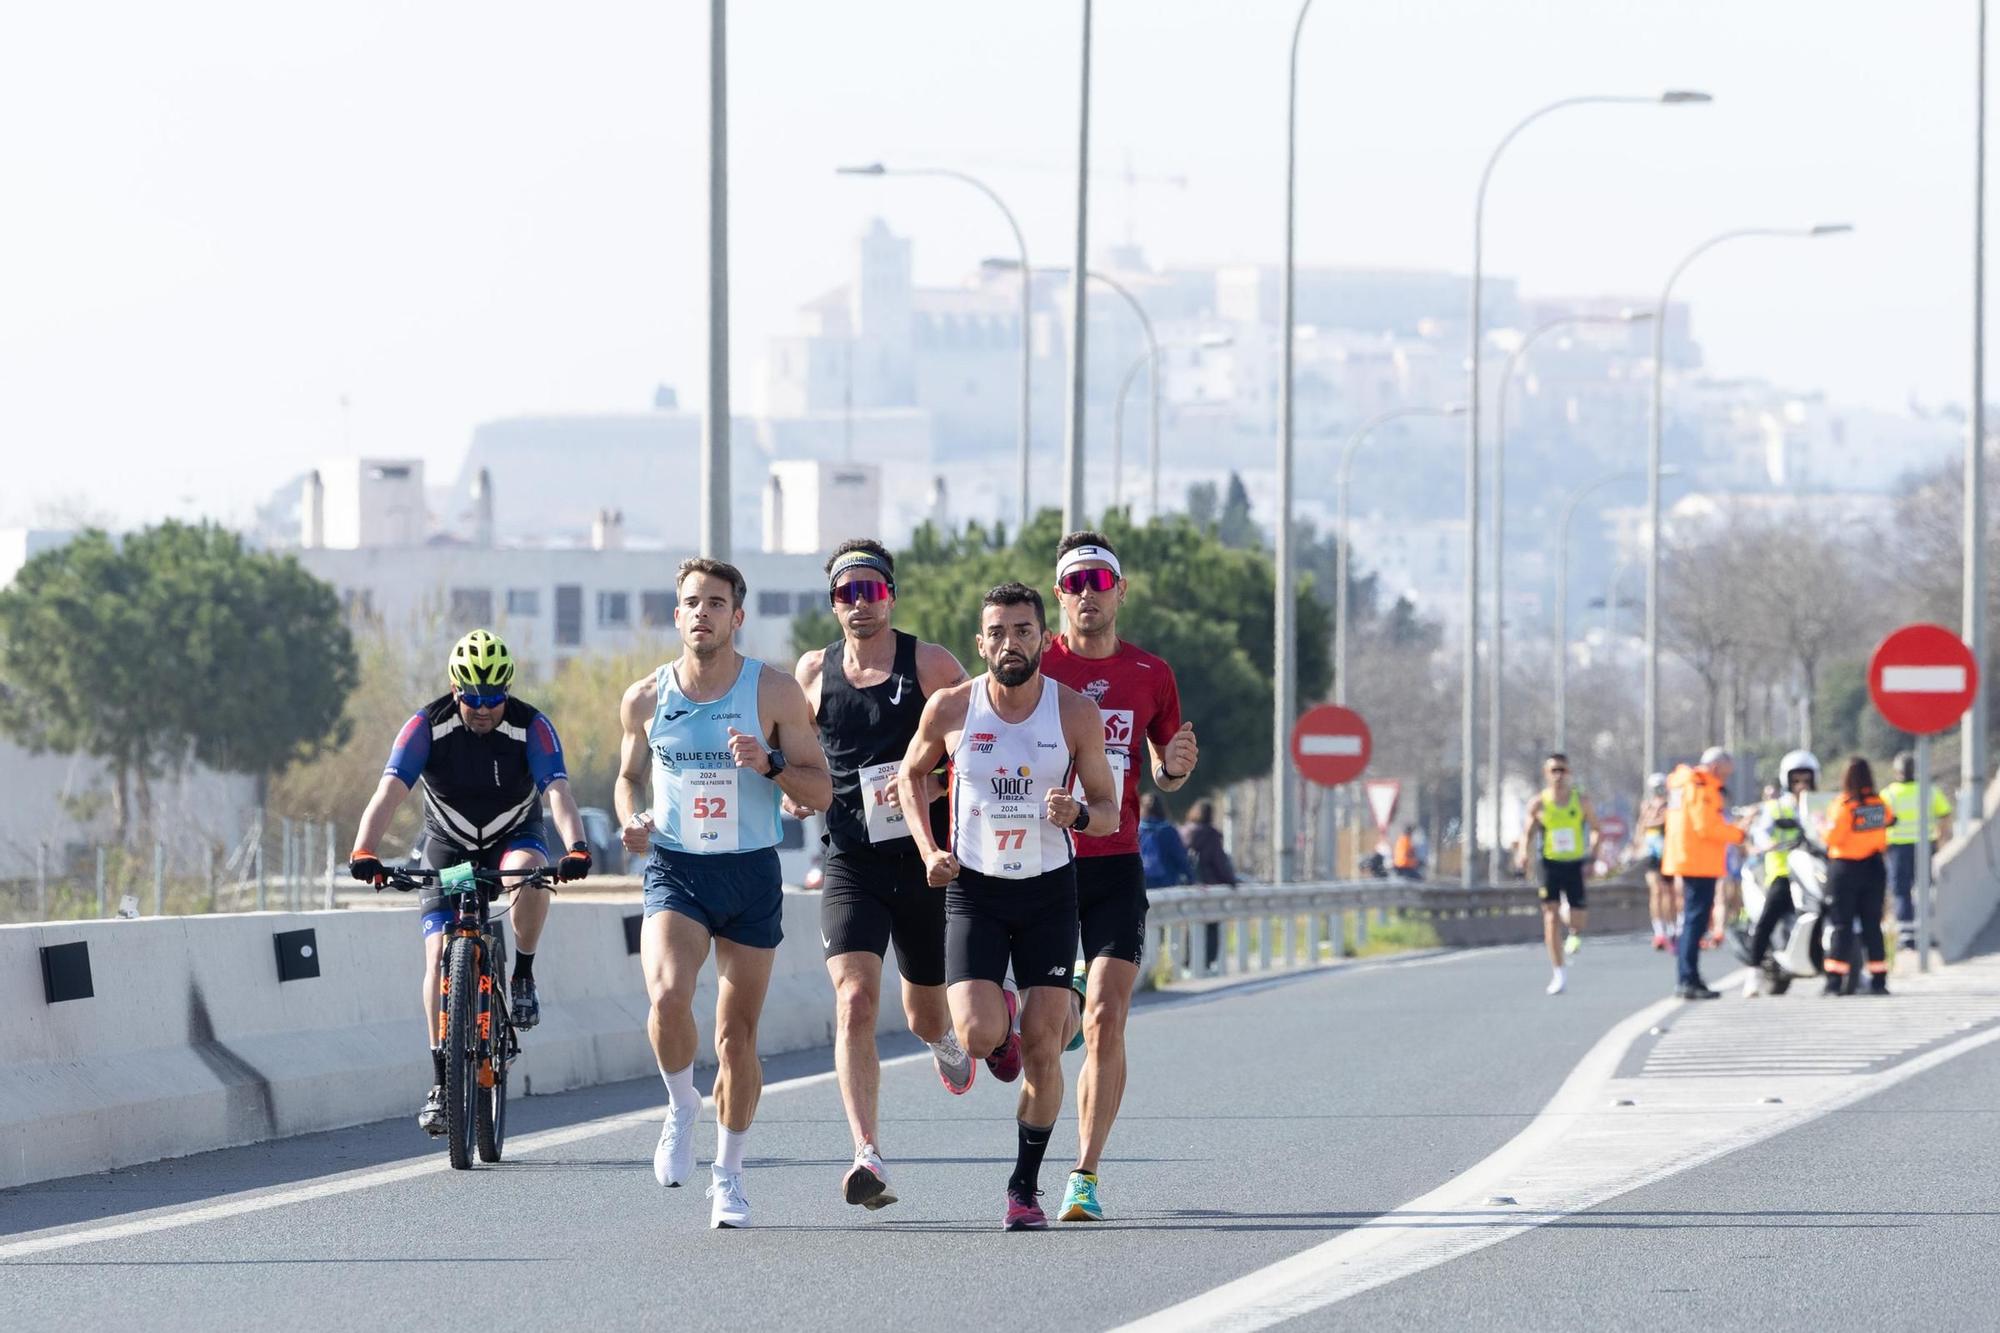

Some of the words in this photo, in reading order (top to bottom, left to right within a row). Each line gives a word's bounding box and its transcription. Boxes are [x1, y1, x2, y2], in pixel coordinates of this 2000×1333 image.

[977, 743, 993, 752] run
[675, 752, 702, 761] BLUE
[705, 751, 731, 760] EYES
[878, 765, 895, 774] 2024
[991, 777, 1033, 800] space
[693, 797, 727, 819] 52
[995, 829, 1027, 851] 77
